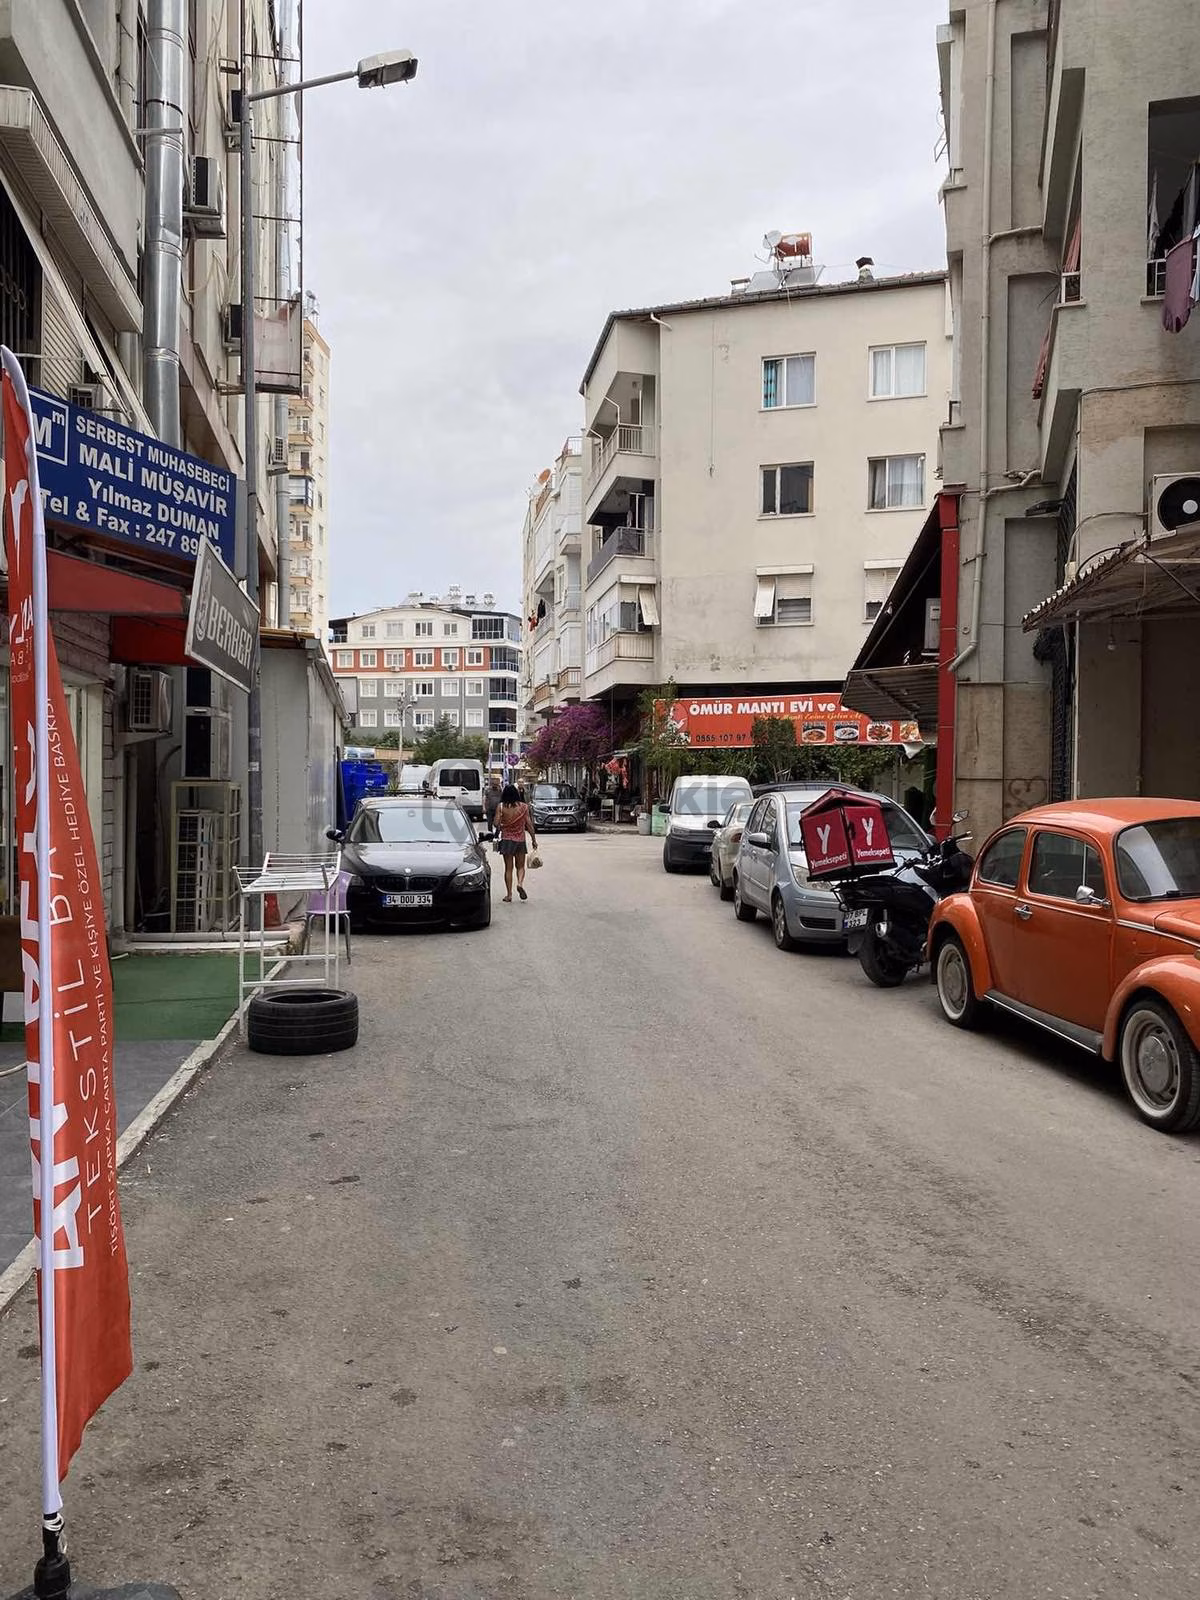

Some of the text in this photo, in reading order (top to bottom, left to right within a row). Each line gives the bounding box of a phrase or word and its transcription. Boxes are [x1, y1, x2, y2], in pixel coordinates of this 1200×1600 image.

[76, 415, 230, 493] SERBEST MUHASEBECİ
[80, 443, 228, 518] MALİ MÜŞAVİR
[40, 487, 69, 516] Tel
[76, 500, 91, 522] &
[97, 507, 130, 535] Fax
[145, 523, 176, 548] 247
[88, 477, 220, 541] Yılmaz DUMAN
[206, 594, 253, 670] BERBER
[689, 701, 733, 716] ÖMÜR
[737, 701, 784, 714] MANTI
[790, 697, 813, 713] EVİ
[818, 702, 835, 713] ve
[57, 772, 81, 840] HEDİYE
[74, 846, 90, 894] ÖZEL
[810, 851, 847, 869] Yemeksepeti
[856, 847, 890, 859] Yemeksepeti
[83, 899, 99, 958] KİŞİYE
[386, 895, 396, 904] 34
[416, 895, 431, 904] 334
[92, 963, 103, 989] VE
[53, 959, 103, 1235] TEKSTİL
